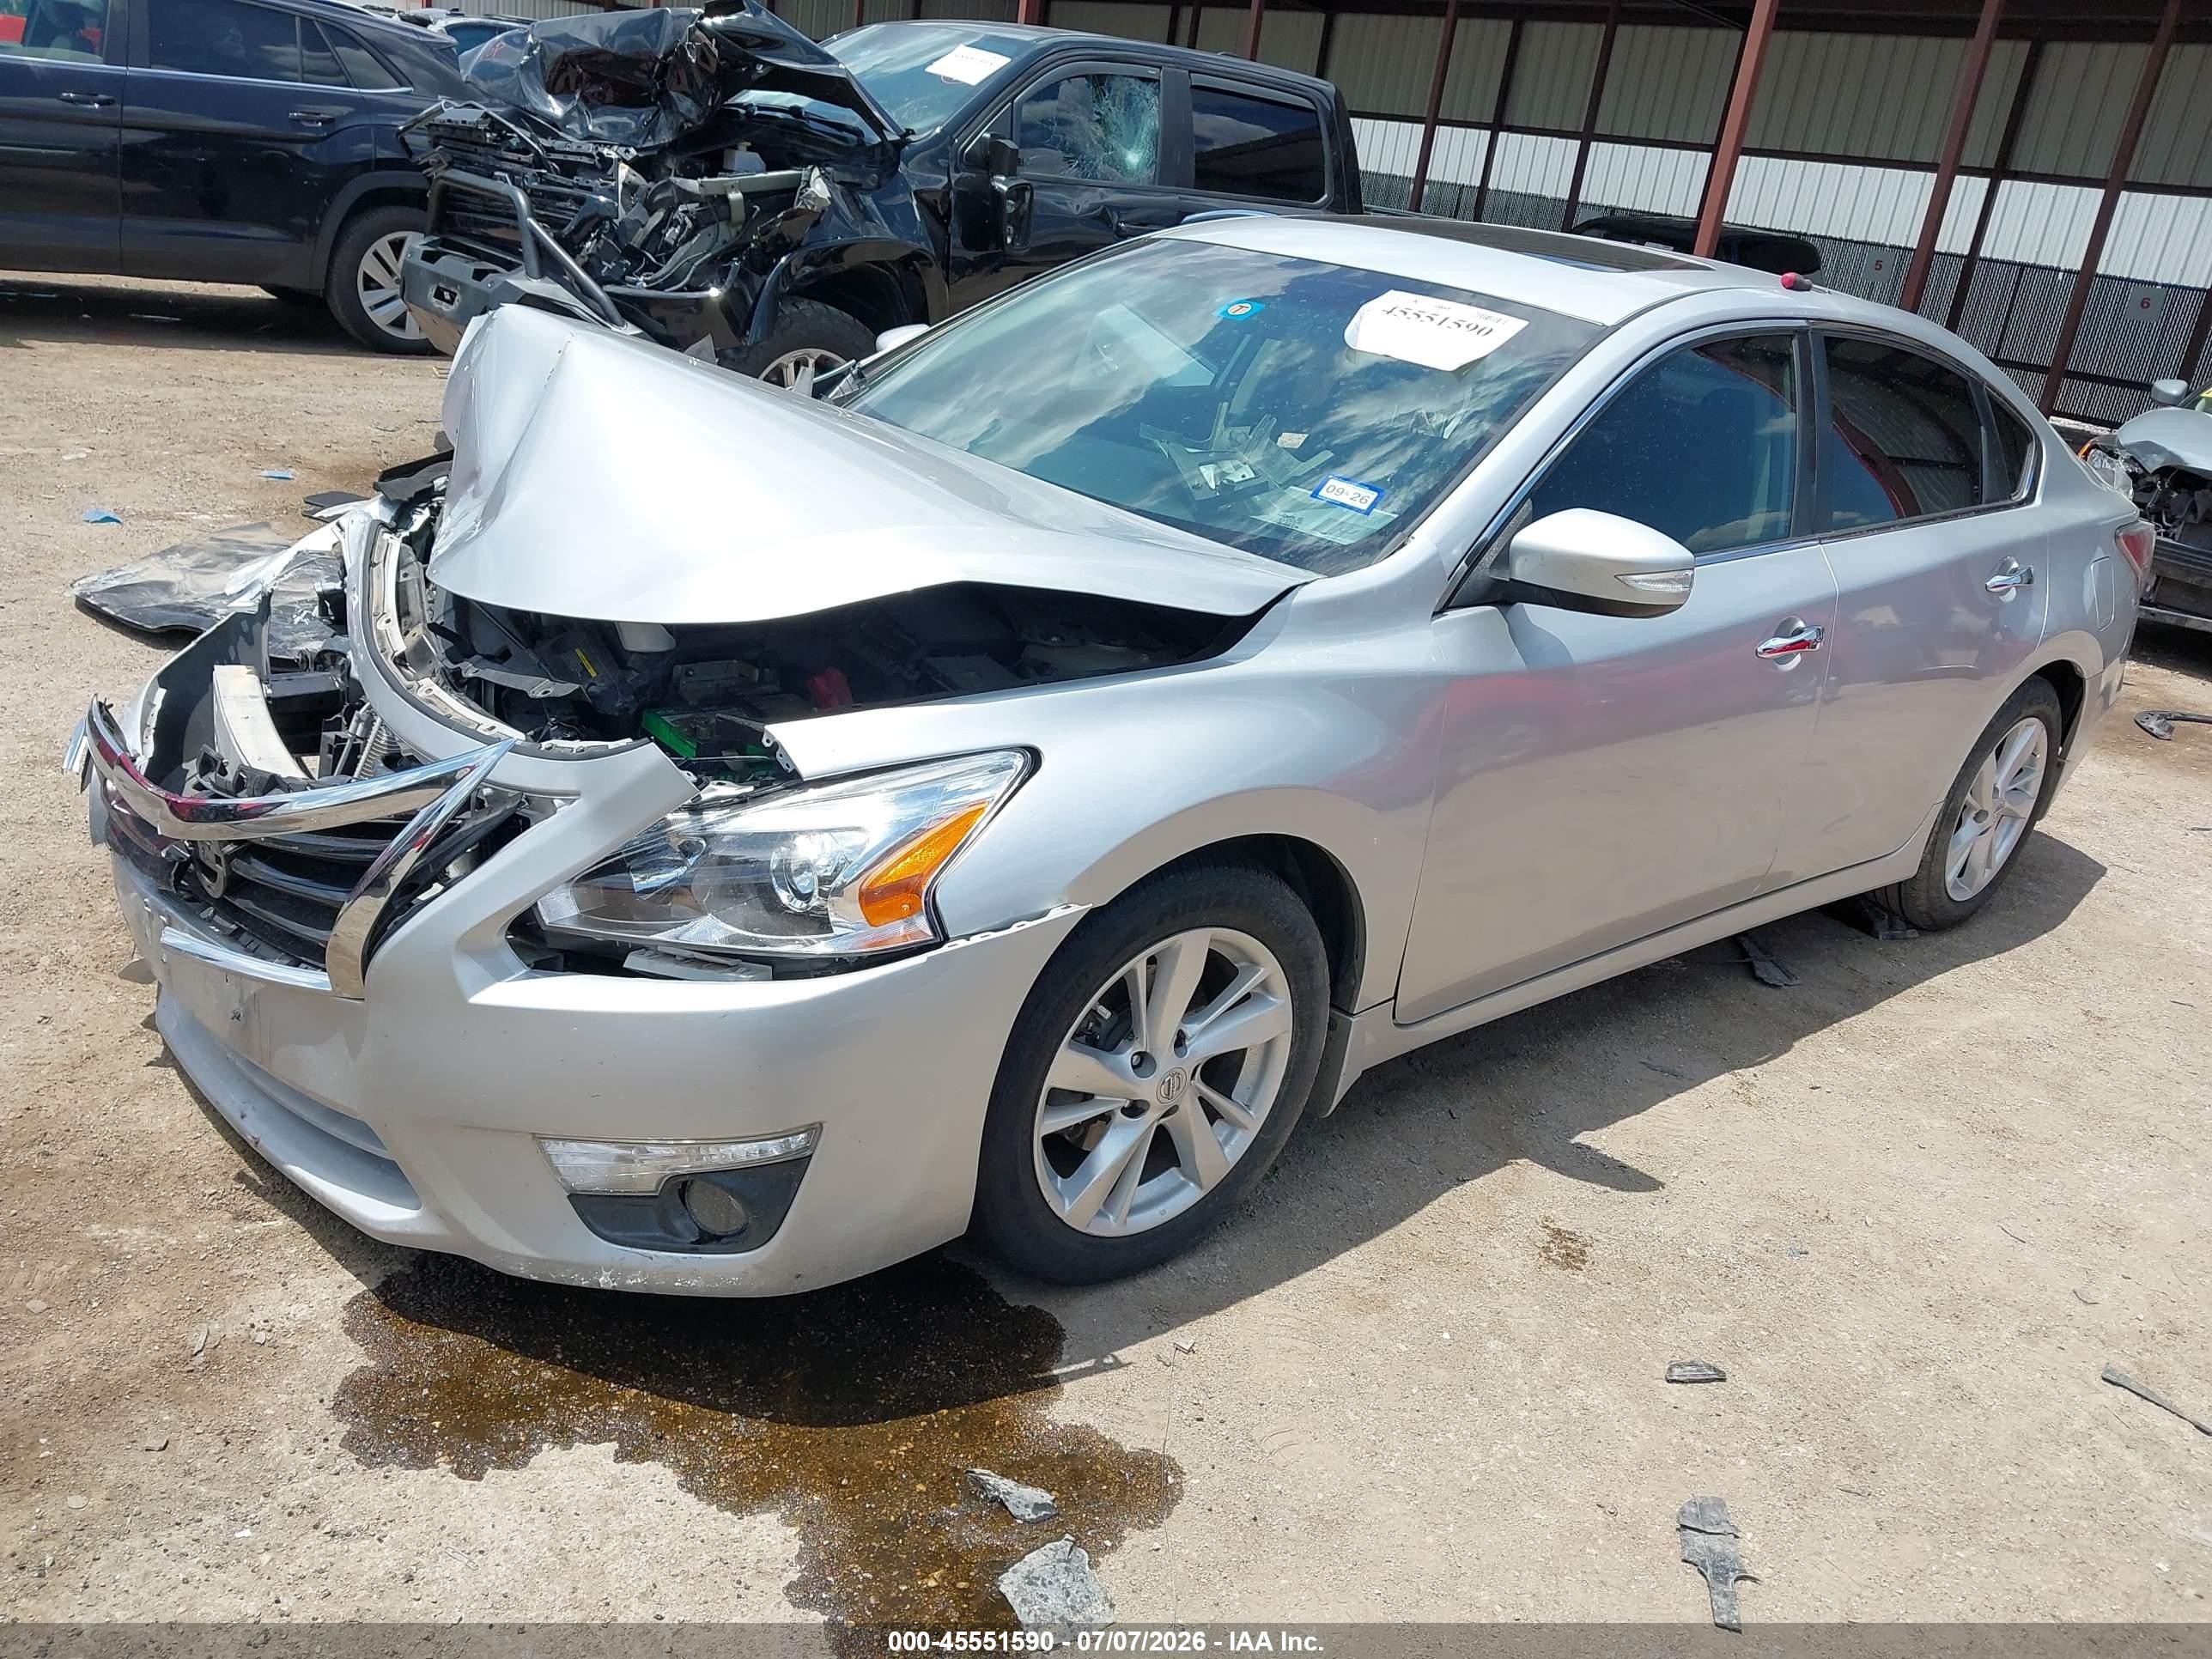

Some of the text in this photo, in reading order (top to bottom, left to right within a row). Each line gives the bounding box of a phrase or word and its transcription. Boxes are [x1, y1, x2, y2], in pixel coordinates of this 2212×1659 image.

[1874, 259, 1884, 271] 5
[2140, 297, 2151, 309] 6
[1382, 306, 1494, 337] 45551590
